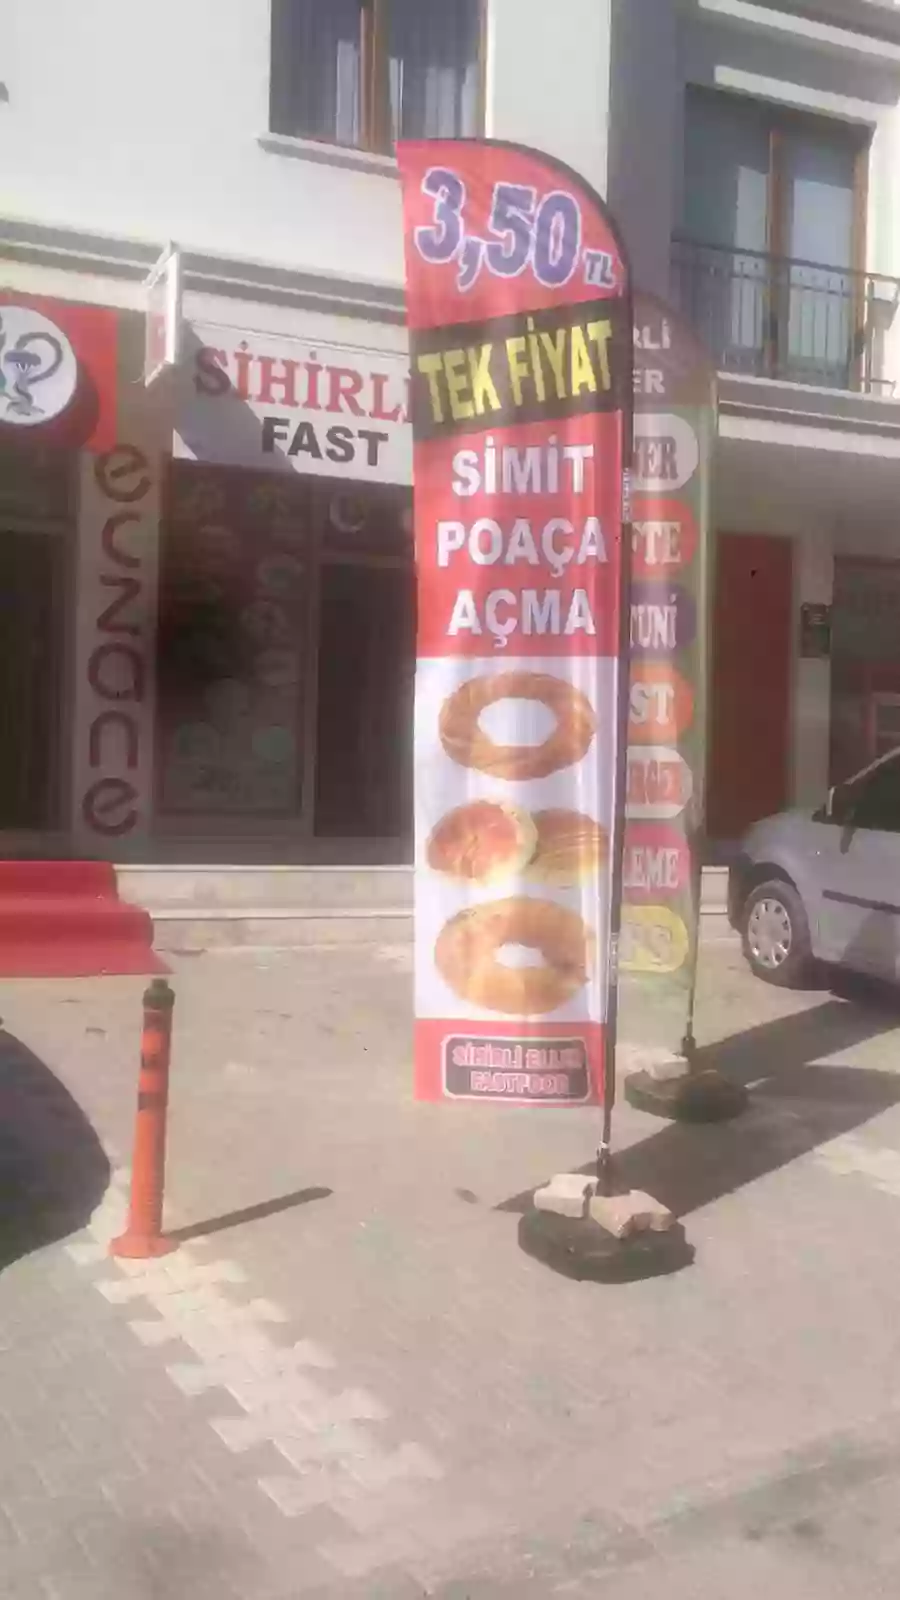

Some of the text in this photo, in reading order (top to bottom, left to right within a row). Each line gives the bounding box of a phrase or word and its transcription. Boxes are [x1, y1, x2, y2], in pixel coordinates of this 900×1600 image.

[414, 167, 616, 292] 3,50 TL
[417, 316, 613, 424] TEK FİYAT
[261, 416, 389, 467] FAST
[451, 435, 594, 496] SİMİT
[437, 516, 608, 578] POAÇA
[83, 443, 152, 837] eczane
[446, 588, 597, 648] AÇMA
